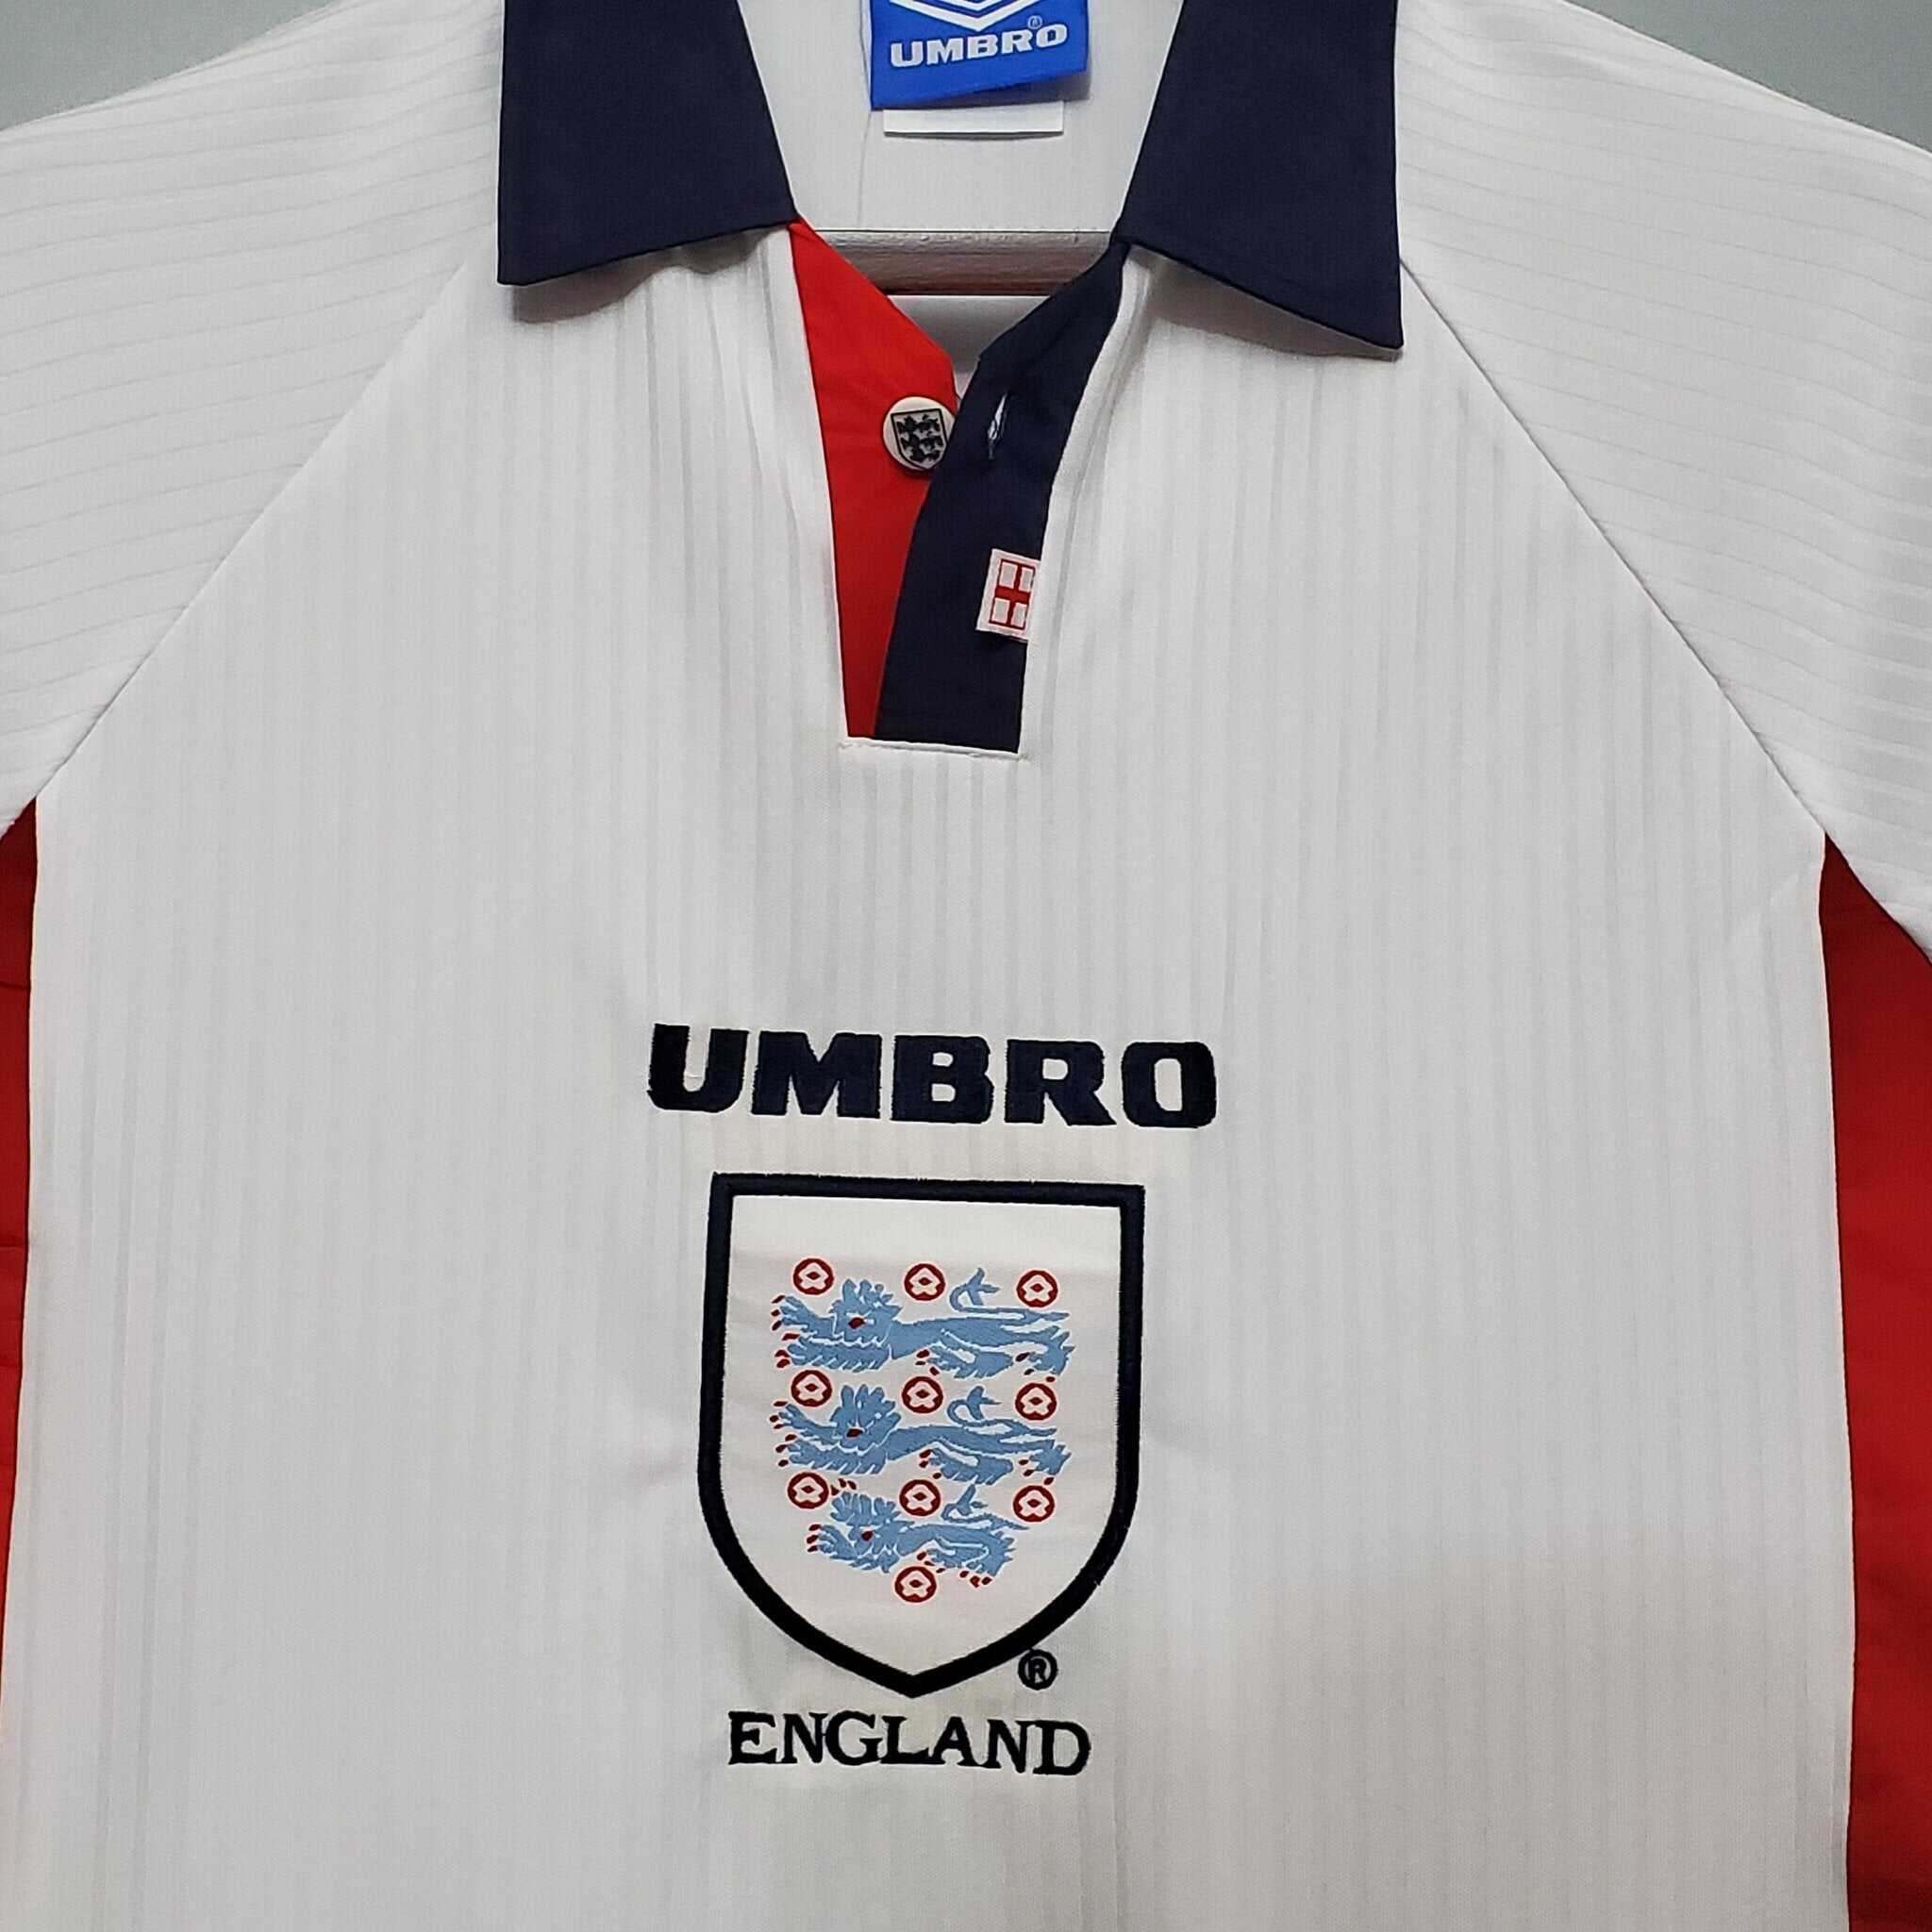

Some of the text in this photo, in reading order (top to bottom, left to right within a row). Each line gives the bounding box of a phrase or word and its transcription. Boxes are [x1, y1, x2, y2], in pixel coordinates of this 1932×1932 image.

[891, 24, 1068, 68] UMBRO
[646, 1024, 1217, 1128] UMBRO
[728, 1709, 1092, 1776] ENGLAND
